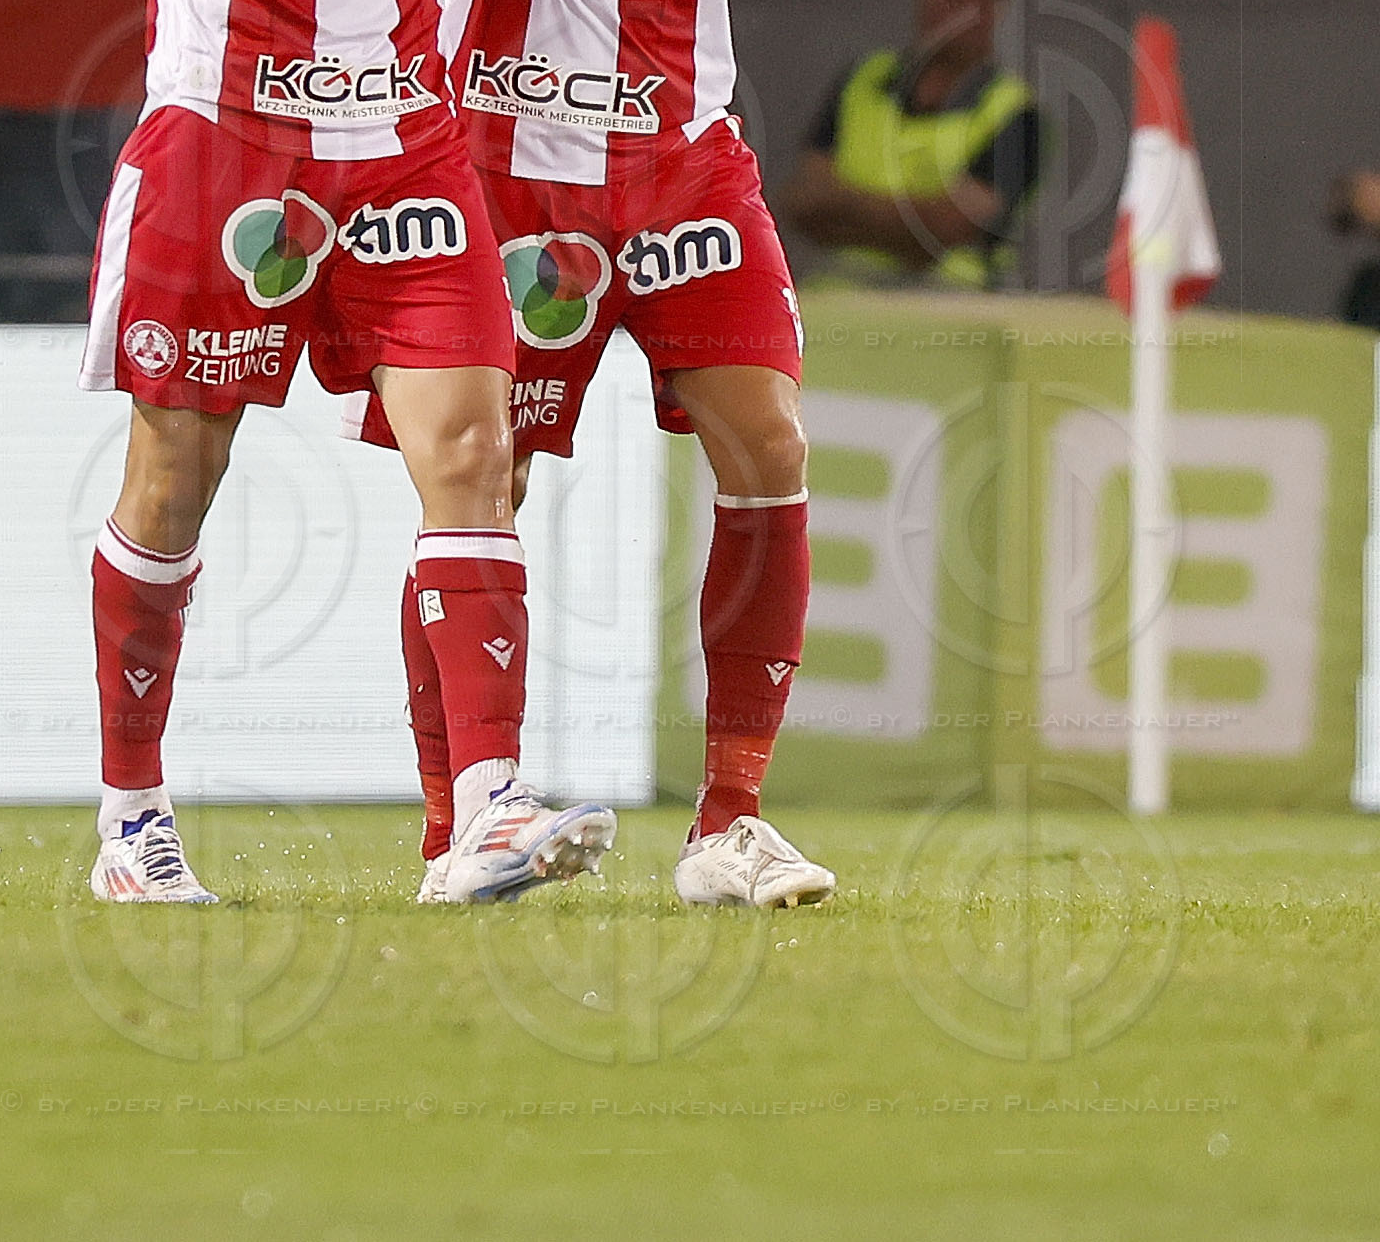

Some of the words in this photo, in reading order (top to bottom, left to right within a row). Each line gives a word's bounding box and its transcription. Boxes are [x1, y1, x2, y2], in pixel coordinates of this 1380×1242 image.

[258, 56, 424, 104] KÖCK
[469, 53, 660, 116] KÖCK
[256, 100, 337, 118] KFZ-TECHNIK
[465, 95, 545, 119] KFZ-TECHNIK
[549, 111, 654, 130] MEISTERBETRIEB
[187, 324, 288, 357] KLEINE
[184, 351, 281, 385] ZEITUNG
